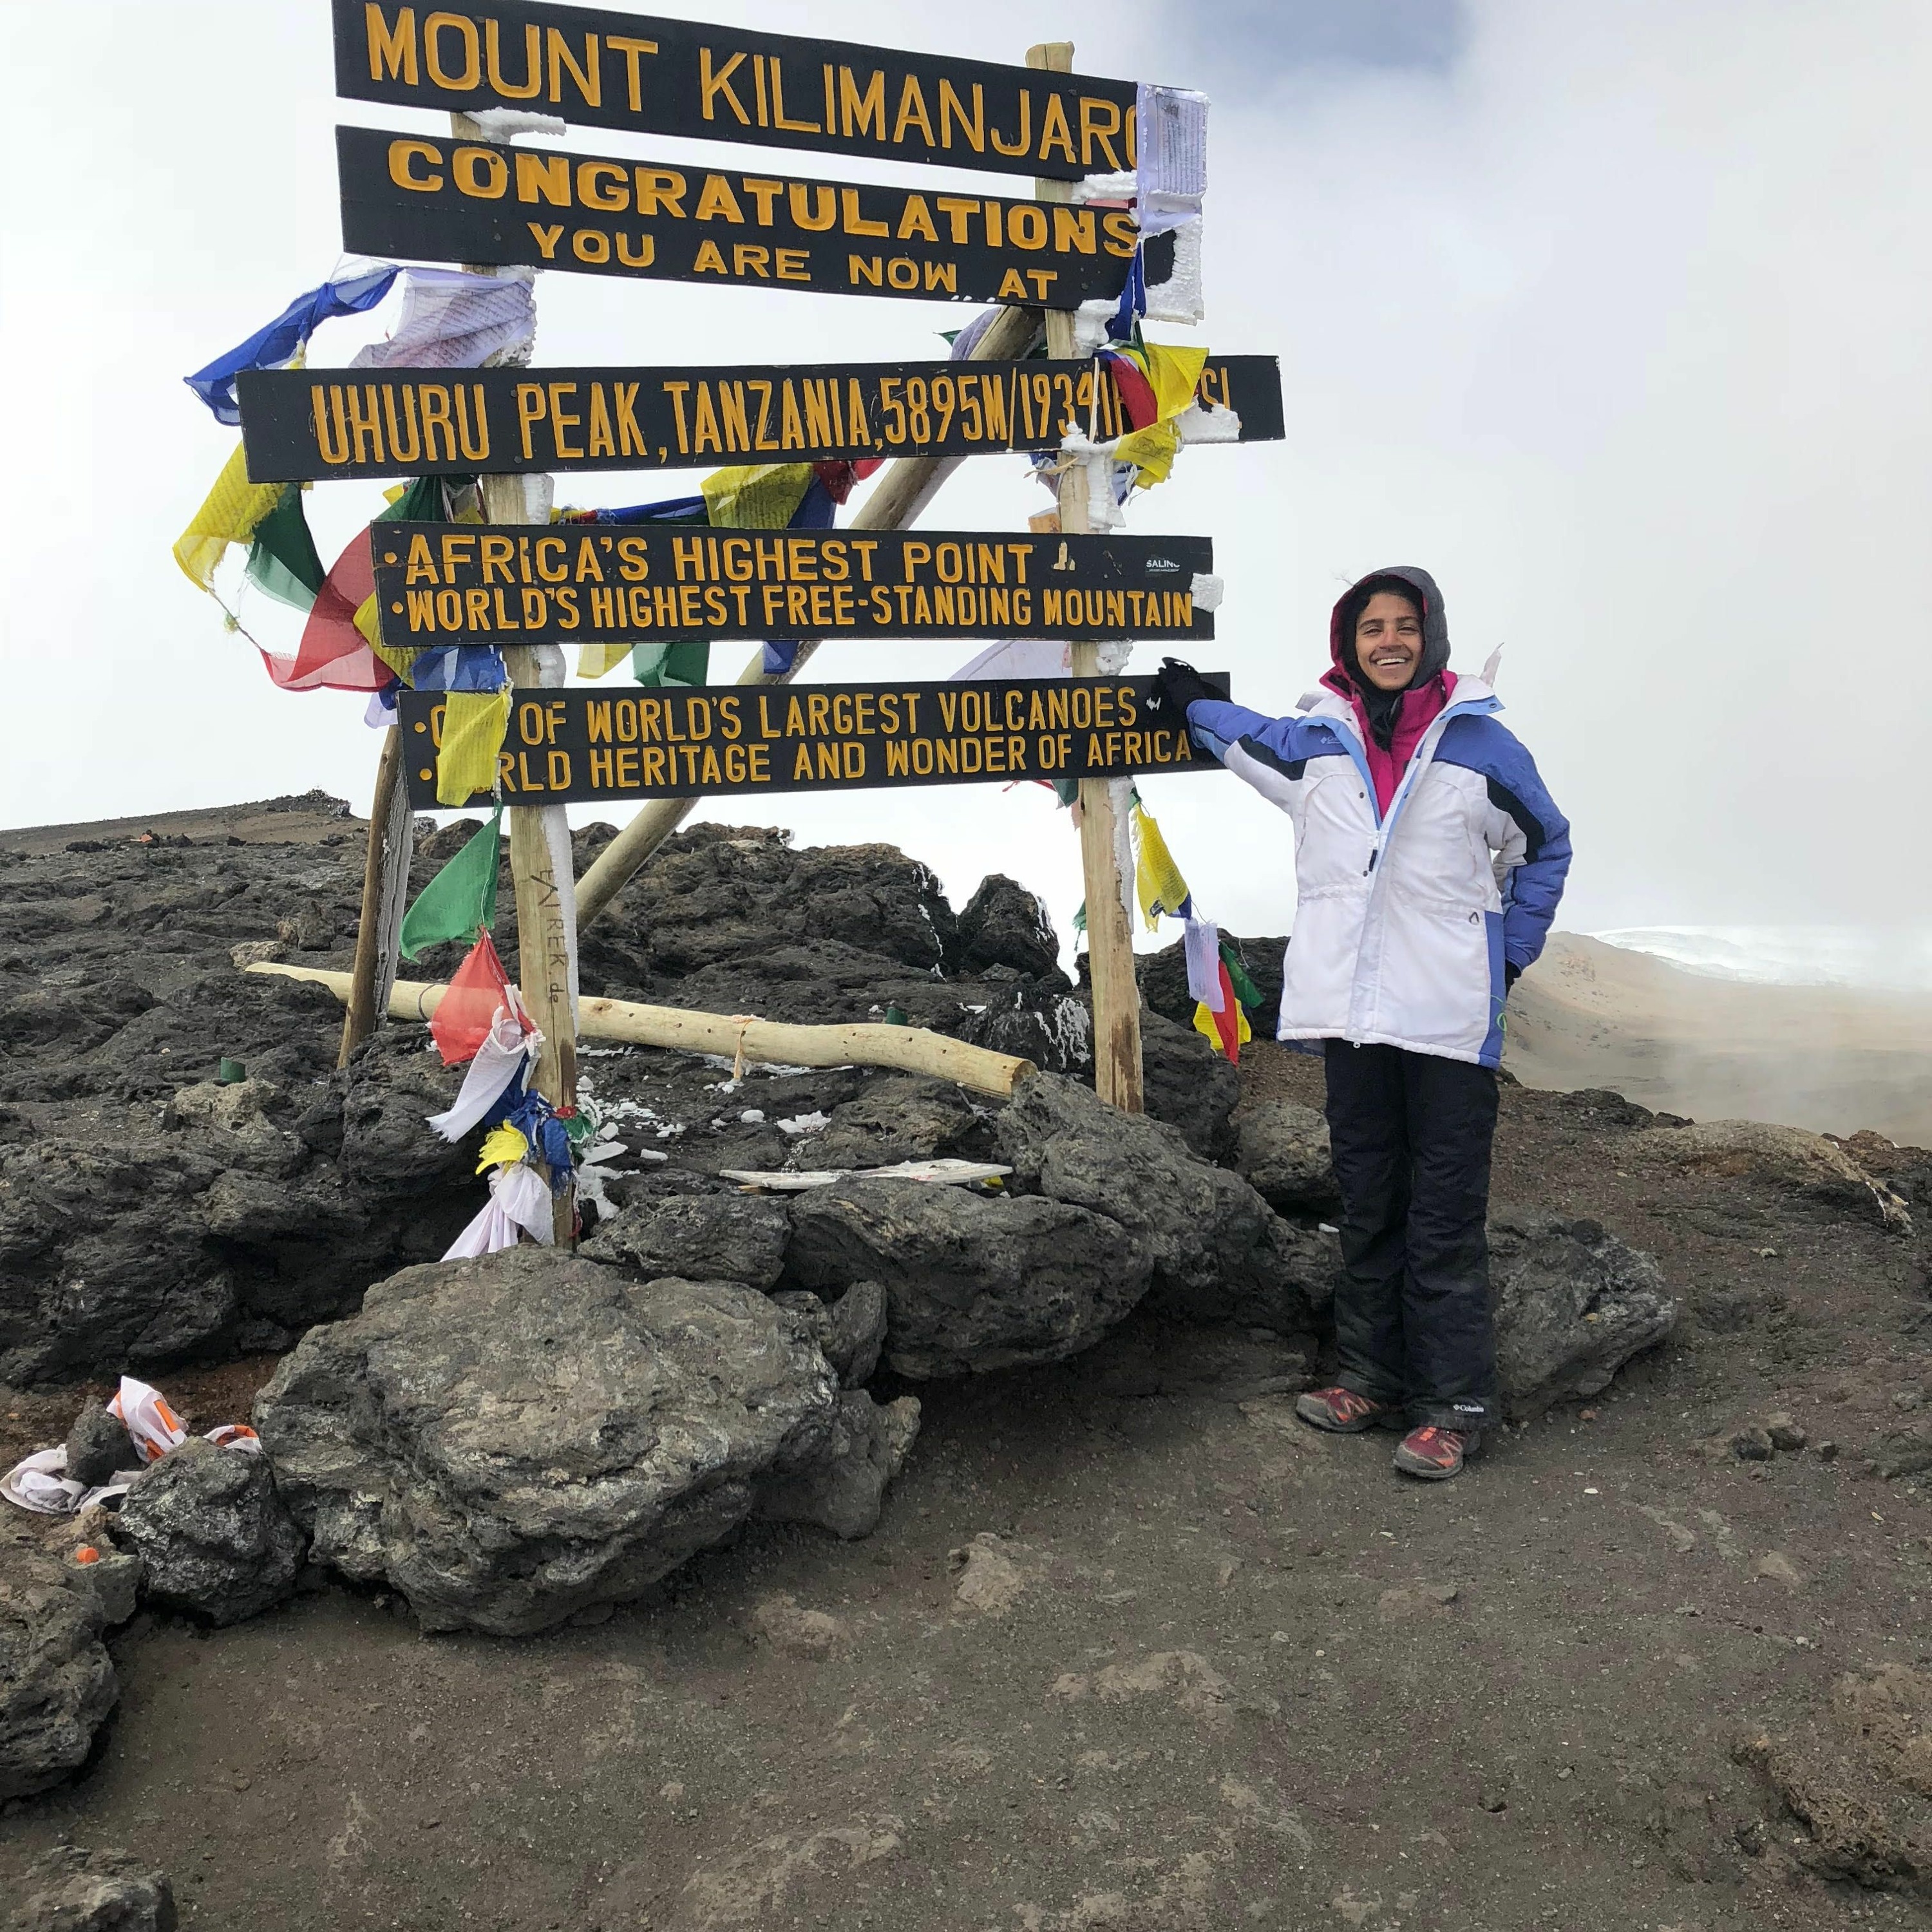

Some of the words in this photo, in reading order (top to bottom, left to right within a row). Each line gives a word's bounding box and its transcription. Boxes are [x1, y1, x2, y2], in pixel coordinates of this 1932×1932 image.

[365, 3, 658, 111] MOUNT
[388, 139, 1137, 258] CONGRATULATIONS
[527, 223, 654, 267] YOU
[693, 240, 810, 281] ARE
[848, 254, 957, 293] NOW
[998, 268, 1057, 300] AT
[311, 383, 489, 464] UHURU
[406, 534, 649, 585] AFRICA'S
[672, 537, 878, 582] HIGHEST
[903, 542, 1034, 584] POINT
[406, 585, 580, 632] WORLD'S
[591, 585, 750, 629] HIGHEST
[762, 585, 1032, 626] FREE-STANDING
[1043, 589, 1193, 627] MOUNTAIN
[519, 701, 566, 746] OF
[587, 696, 742, 743] WORLD'S
[759, 693, 921, 739] LARGEST
[938, 687, 1136, 733] VOLCANOES
[589, 743, 770, 788] HERITAGE
[793, 741, 866, 780] AND
[886, 735, 1027, 777] WONDER
[1038, 733, 1072, 770] OF
[1087, 730, 1192, 768] AFRICA
